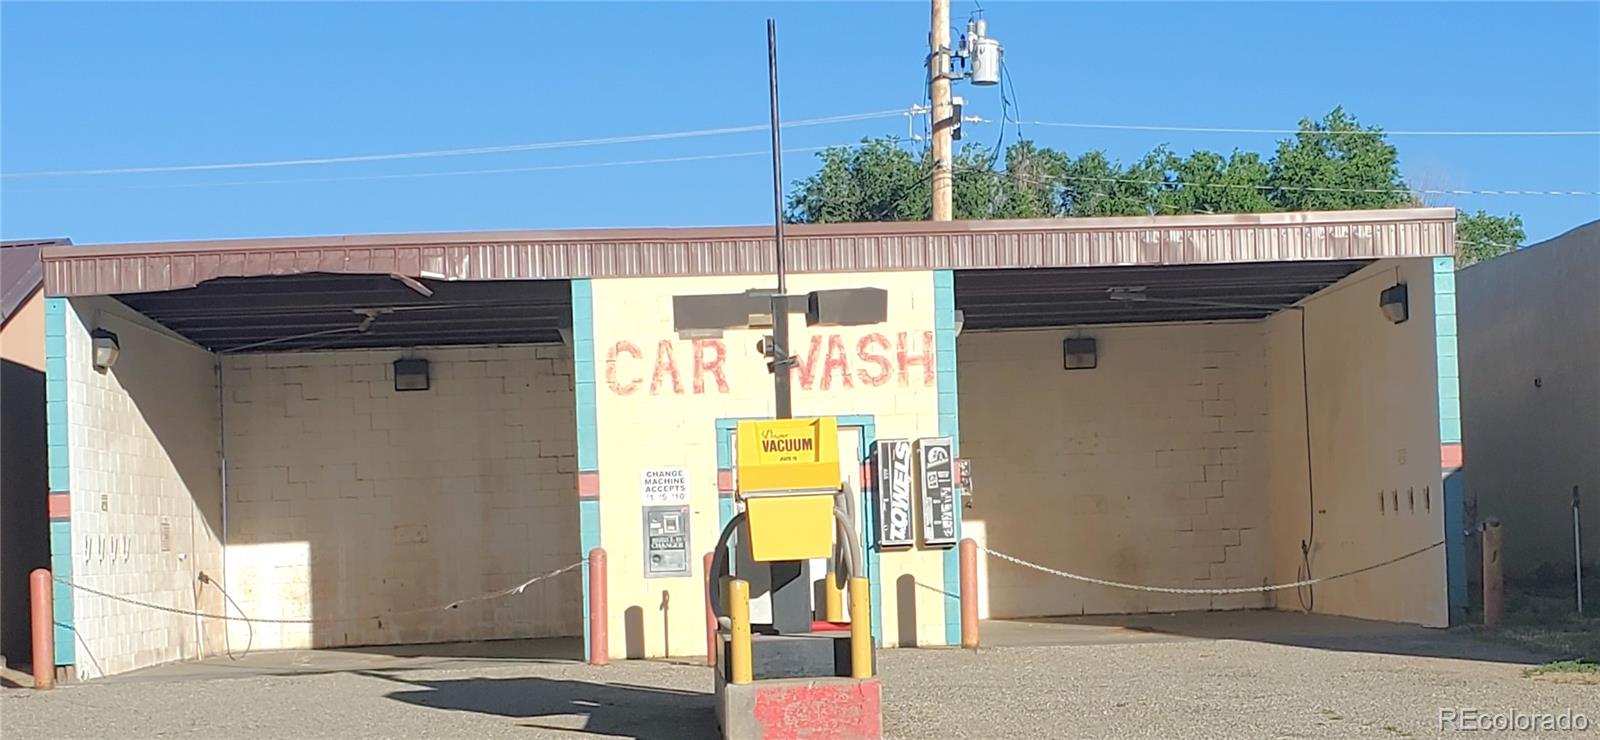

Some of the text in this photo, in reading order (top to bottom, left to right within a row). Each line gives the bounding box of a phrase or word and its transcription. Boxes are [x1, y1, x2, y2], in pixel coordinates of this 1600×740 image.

[605, 331, 934, 396] CAR WASH
[761, 438, 813, 453] VACUUM
[646, 470, 684, 478] CHANGE
[644, 477, 686, 486] MACHINE
[645, 485, 686, 493] ACCEPTS
[889, 441, 911, 541] TOWELS
